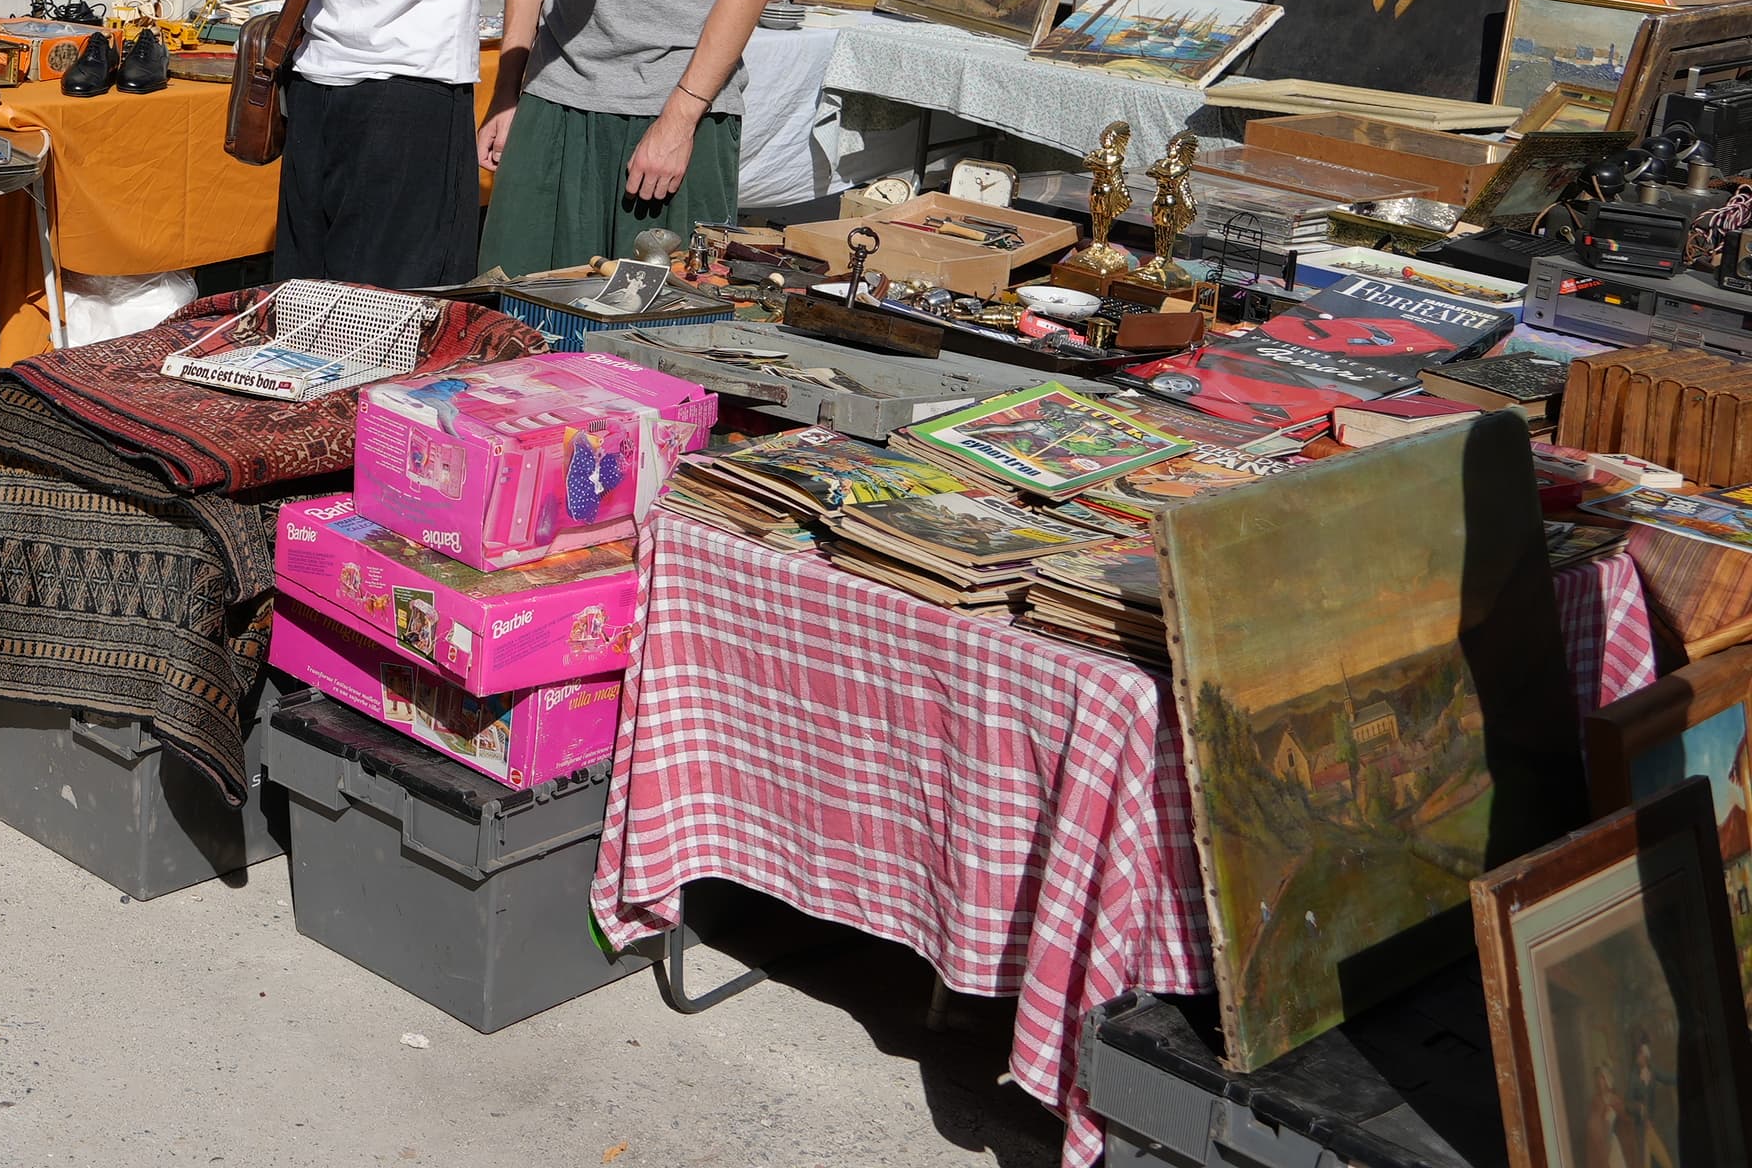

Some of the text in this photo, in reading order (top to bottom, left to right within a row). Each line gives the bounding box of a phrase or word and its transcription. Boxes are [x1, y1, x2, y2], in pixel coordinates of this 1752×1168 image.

[1332, 277, 1494, 330] FERRARI
[1421, 298, 1500, 320] FANTASTIQUES
[1250, 335, 1332, 360] VOITURES
[584, 353, 644, 373] Barbie
[1256, 347, 1374, 382] Ferrari
[234, 371, 255, 387] très
[256, 374, 280, 392] bon.
[961, 439, 1042, 477] cybertron
[304, 497, 355, 521] Barb
[983, 498, 1100, 538] CONAN
[286, 522, 318, 543] Barbie
[422, 529, 462, 554] Barbie
[491, 609, 534, 639] Barbie
[543, 678, 583, 712] Barbie
[569, 690, 591, 711] villa
